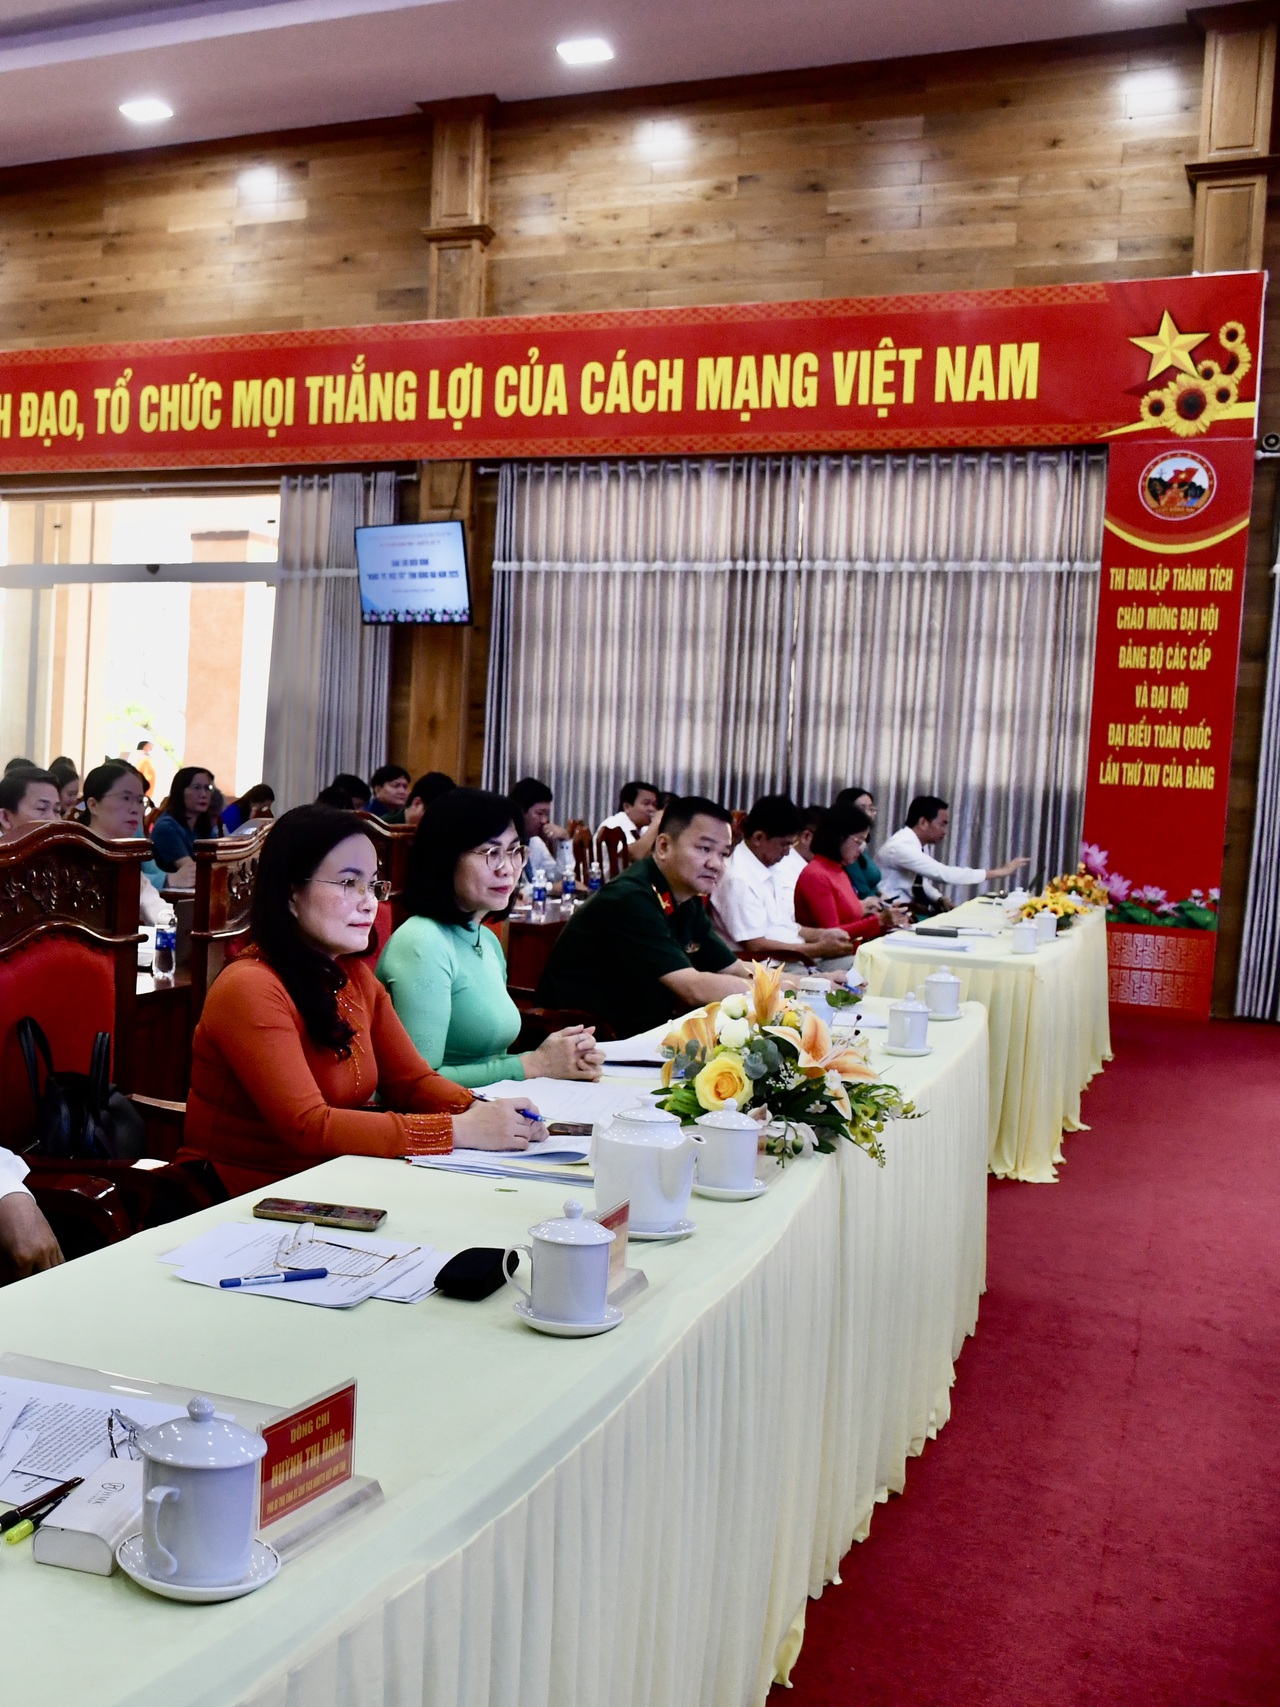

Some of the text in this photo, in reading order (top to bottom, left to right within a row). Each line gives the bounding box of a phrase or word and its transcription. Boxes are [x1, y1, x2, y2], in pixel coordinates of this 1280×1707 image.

[20, 390, 85, 447] ĐẠO,
[94, 368, 134, 435] TỔ
[140, 373, 223, 433] CHỨC
[233, 378, 296, 438] MỌI
[306, 354, 418, 426] THẮNG
[428, 362, 484, 431] LỢI
[495, 347, 569, 419] CỦA
[581, 349, 685, 416] CÁCH
[697, 352, 820, 423] MẠNG
[833, 337, 924, 419] VIỆT
[935, 342, 1041, 403] NAM
[1109, 563, 1234, 596] THI ĐUA LẬP THÀNH TÍCH
[1117, 602, 1219, 636] CHÀO MỪNG ĐẠI HỘI
[1119, 638, 1212, 675] ĐẢNG BỘ CÁC CẤP
[1135, 680, 1190, 714] VÀ ĐẠI HỘI
[1108, 715, 1212, 752] ĐẠI BIỂU TOÀN QUỐC
[1121, 758, 1143, 787] THỨ
[1142, 763, 1161, 787] XIV
[1162, 756, 1183, 788] CỦA
[1184, 758, 1216, 790] ĐẢNG
[271, 1451, 303, 1489] HUỲNH
[305, 1442, 320, 1469] THỊ
